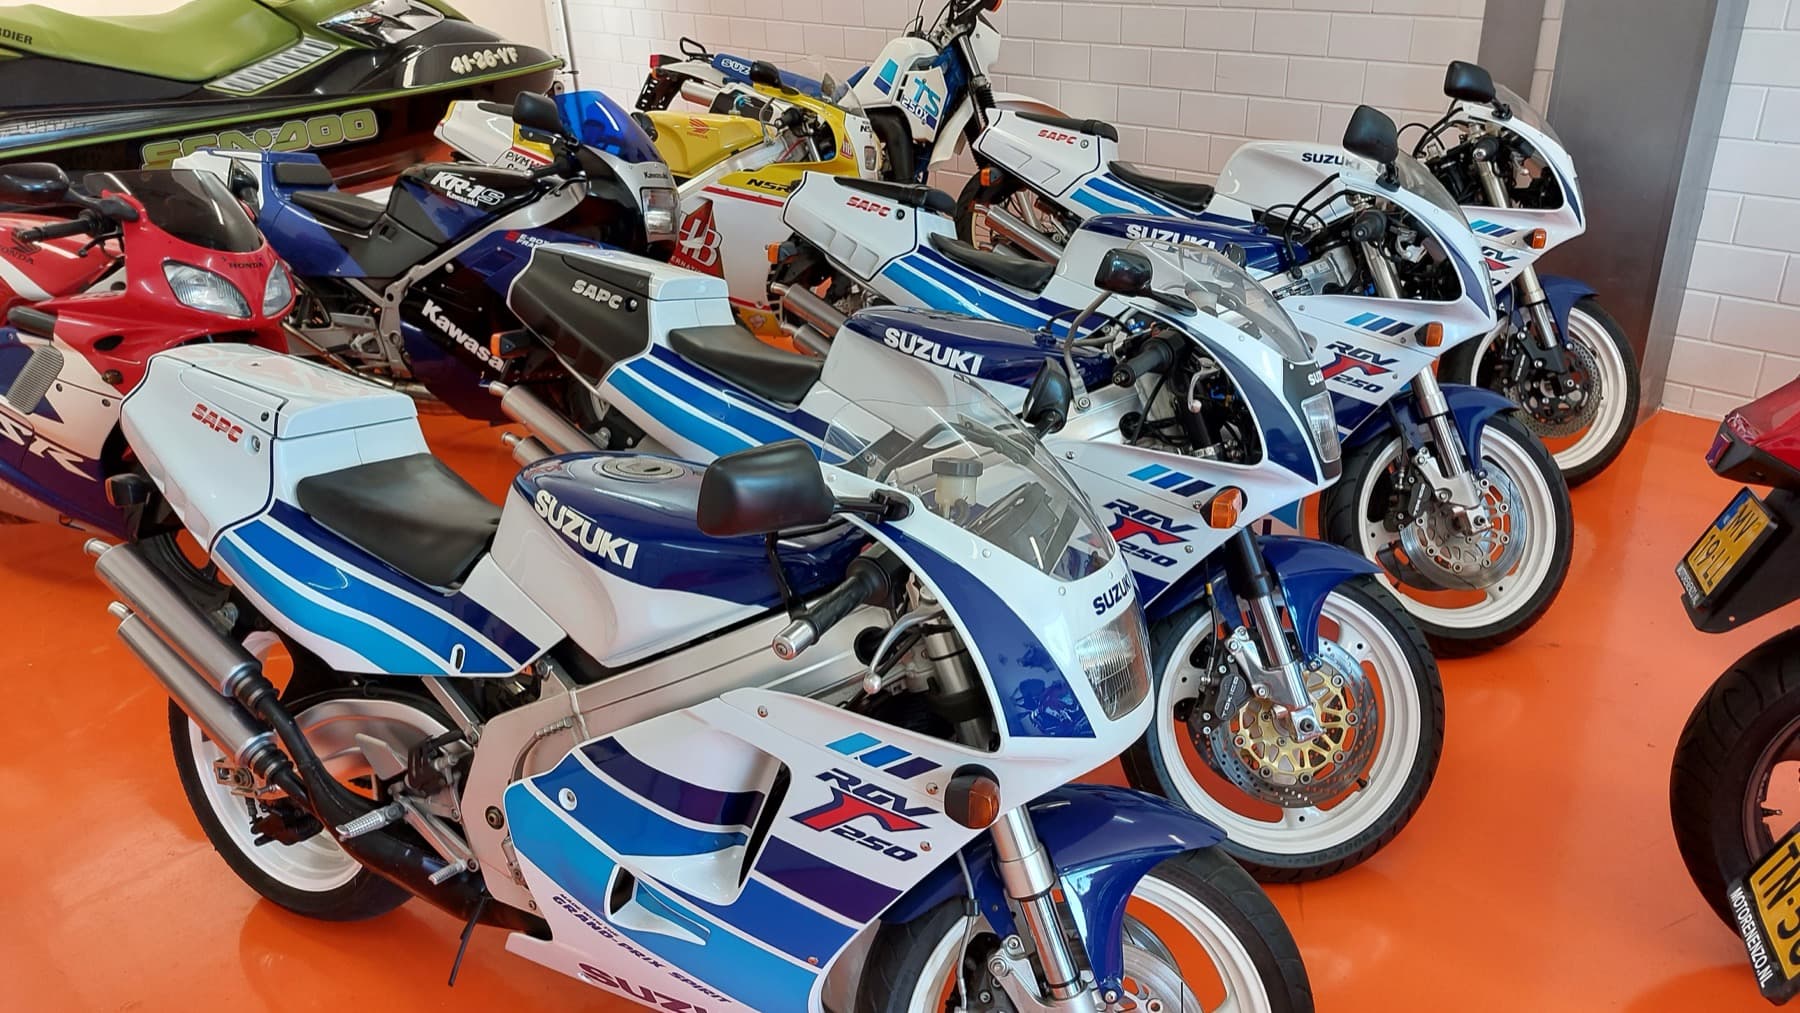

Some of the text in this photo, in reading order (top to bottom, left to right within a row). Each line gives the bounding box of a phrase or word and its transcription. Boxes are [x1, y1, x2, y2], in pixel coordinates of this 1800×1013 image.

[0, 28, 33, 45] DIER
[721, 58, 751, 76] SUZ
[1038, 129, 1077, 145] SAPC
[846, 196, 891, 217] SAPC
[0, 246, 34, 265] ONDA
[1481, 246, 1521, 262] GV
[572, 279, 624, 310] SAPC
[421, 298, 505, 373] Kawasa
[883, 326, 985, 377] SUZUKI
[1324, 341, 1401, 366] RGV
[1331, 374, 1384, 393] 250
[191, 402, 244, 443] SAPC
[534, 489, 640, 570] SUZUKI
[1102, 498, 1200, 533] RGV
[1118, 540, 1179, 568] 250
[1092, 573, 1132, 616] SUZUK
[814, 767, 942, 817] RGV
[830, 824, 919, 862] 250
[1729, 886, 1774, 989] MOTORENENZO.NL
[578, 962, 709, 1013] SUZ
[668, 971, 732, 1004] SPIRIT
